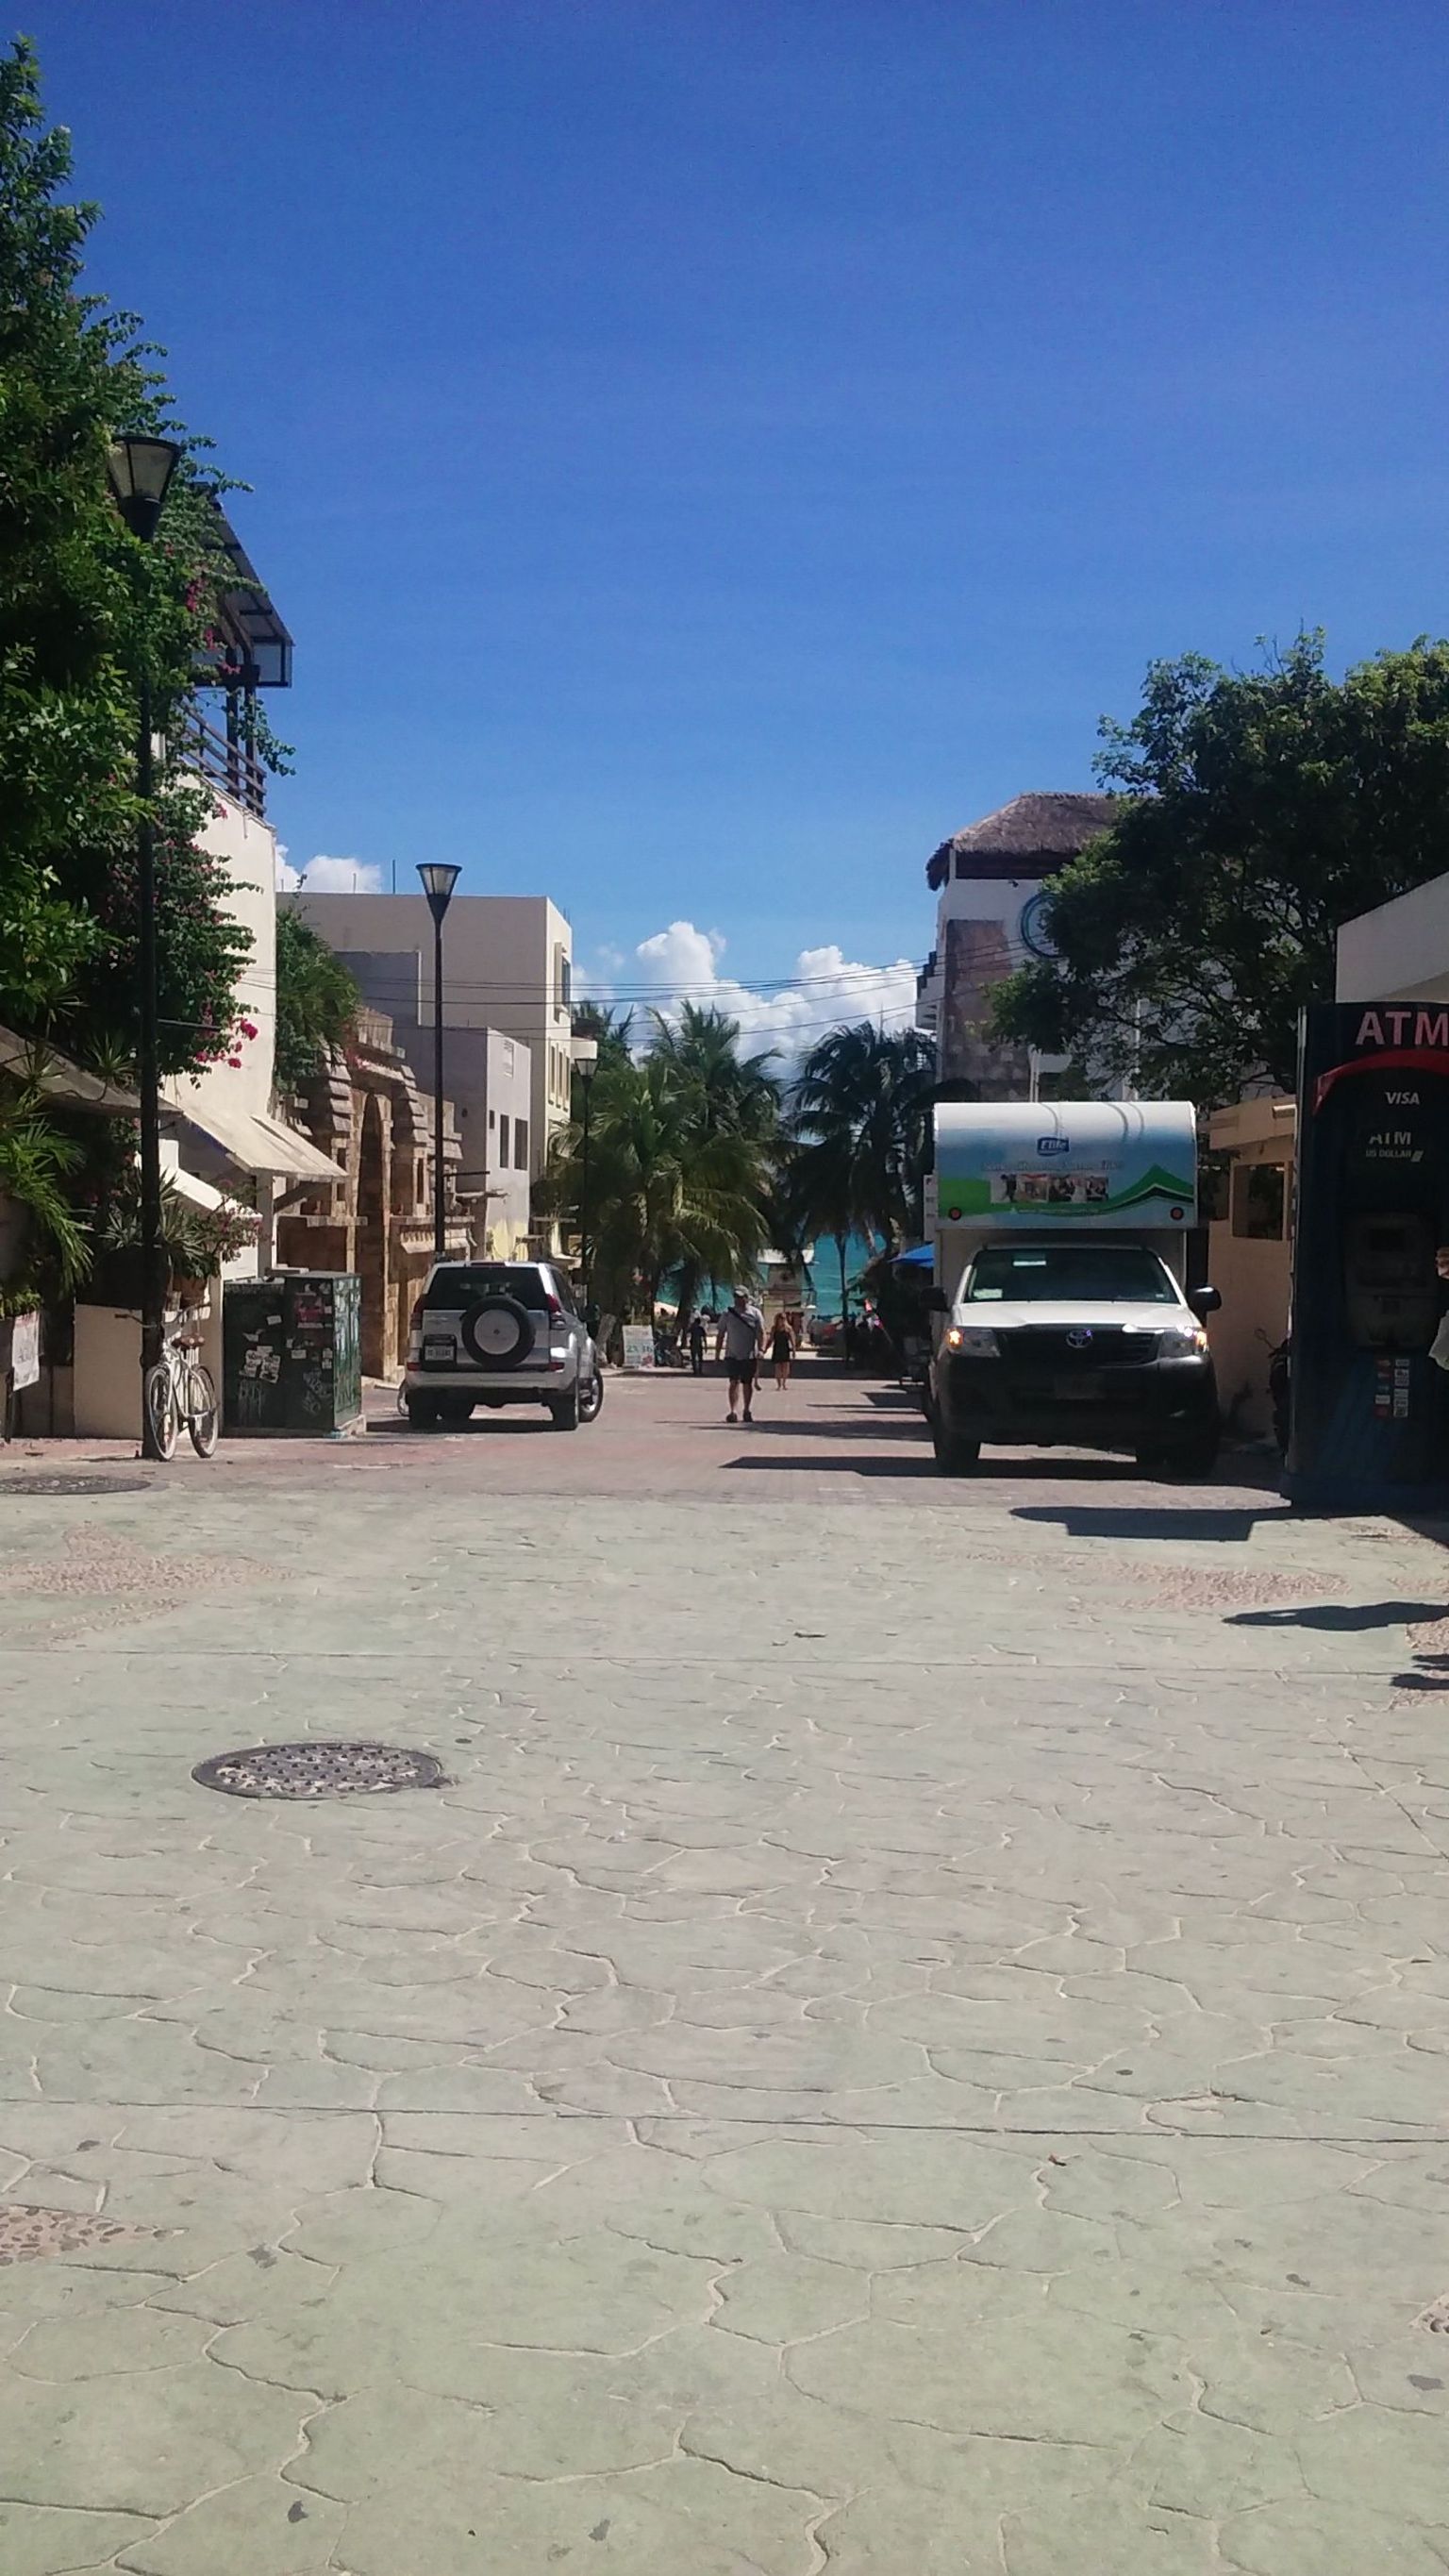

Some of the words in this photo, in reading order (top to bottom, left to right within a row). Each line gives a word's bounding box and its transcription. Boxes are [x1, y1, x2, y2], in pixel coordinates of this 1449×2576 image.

[1355, 1011, 1449, 1046] ATM
[1385, 1091, 1420, 1105] VISA
[1369, 1131, 1412, 1146] ATM
[1365, 1149, 1376, 1158] US
[1378, 1149, 1412, 1159] DOLLAR
